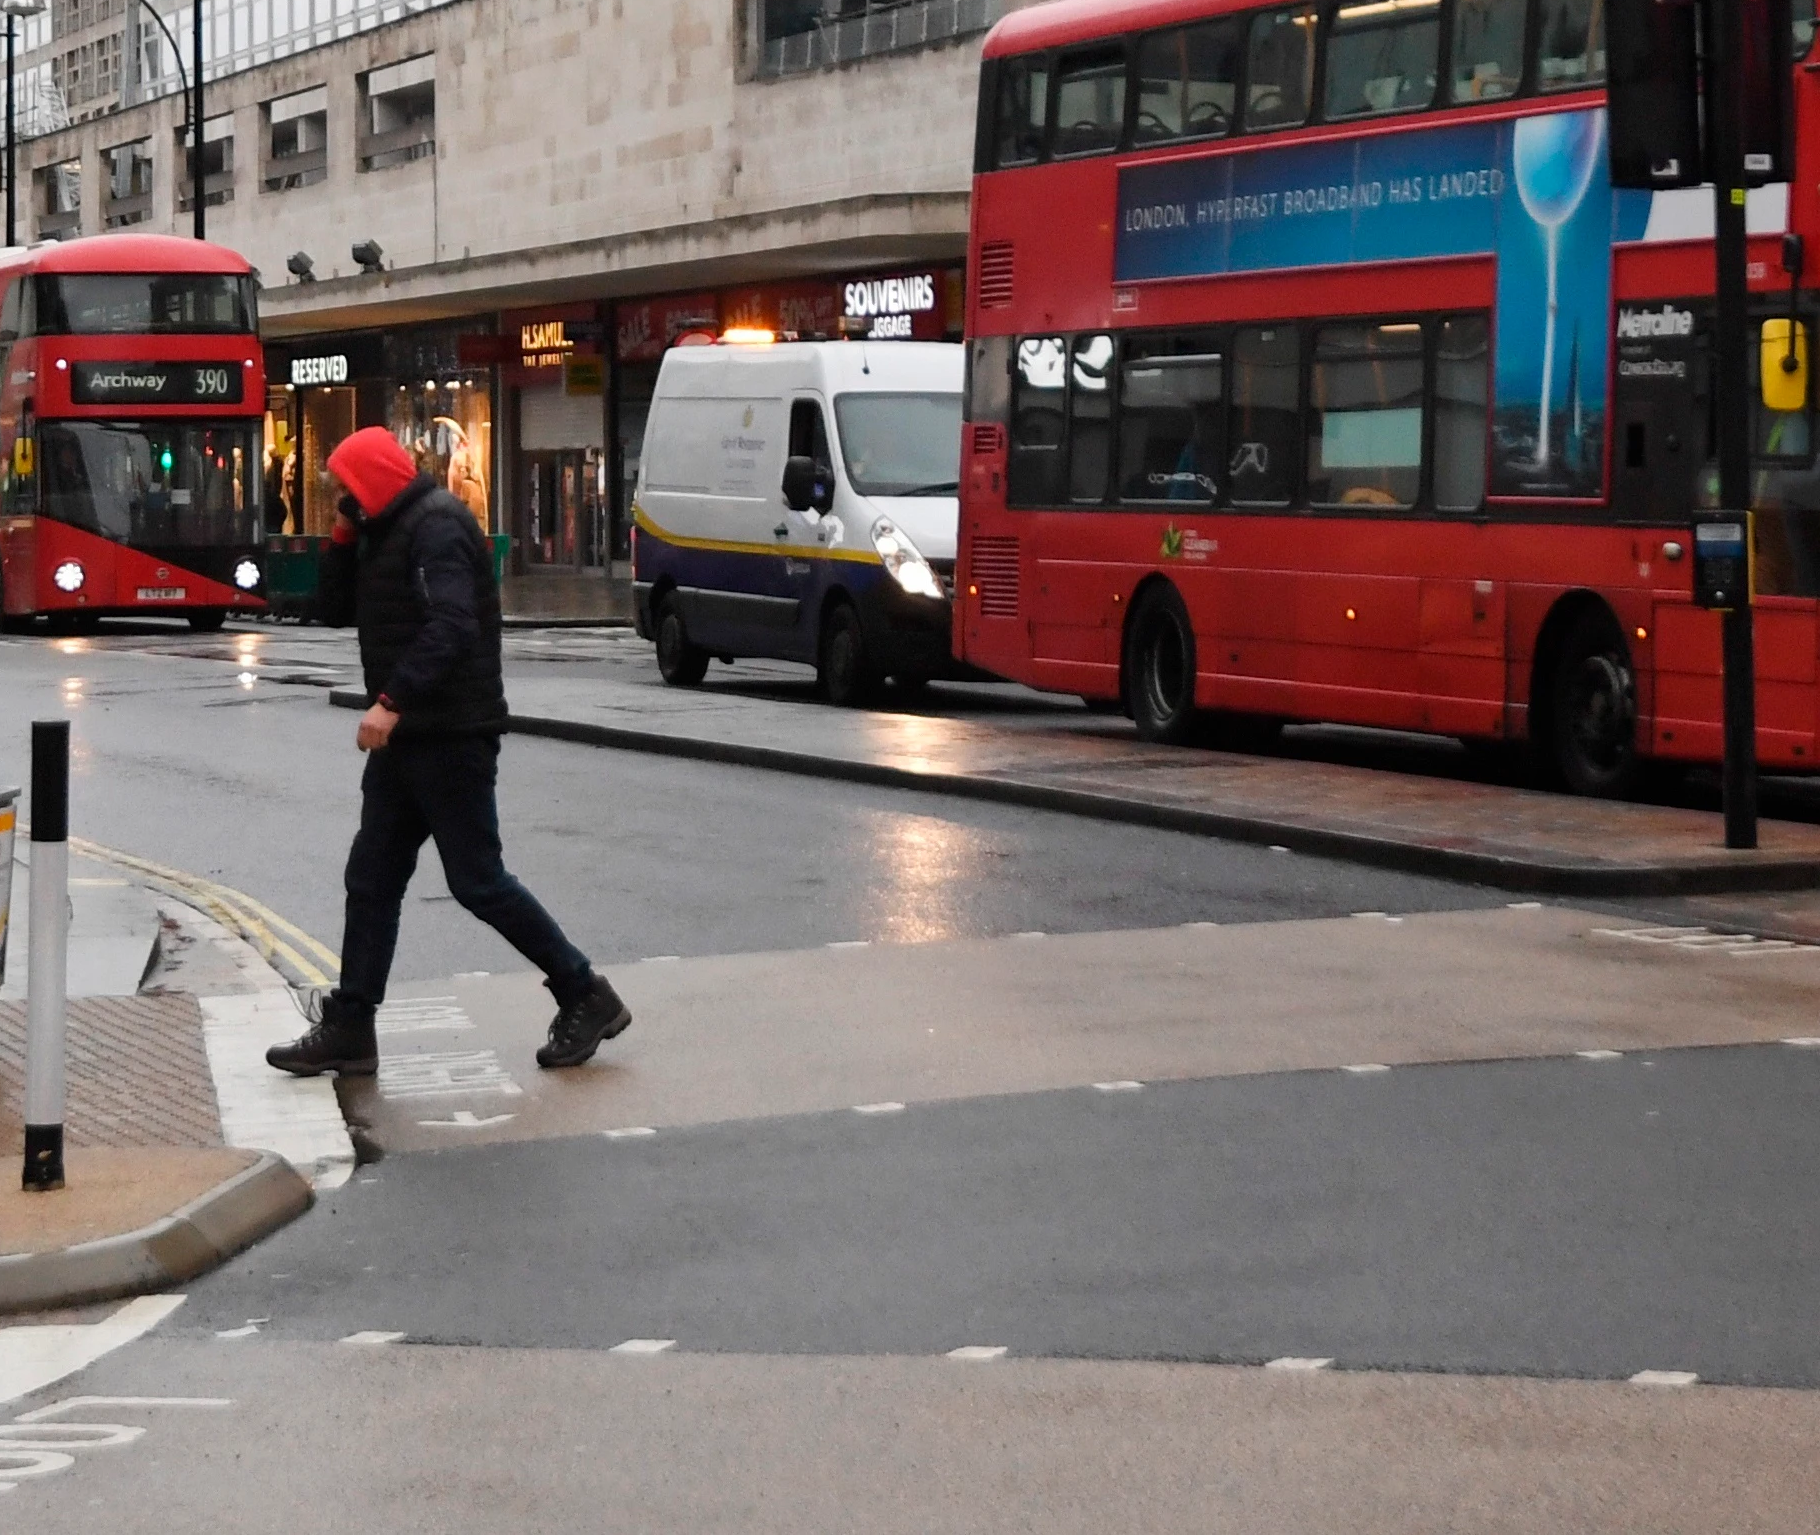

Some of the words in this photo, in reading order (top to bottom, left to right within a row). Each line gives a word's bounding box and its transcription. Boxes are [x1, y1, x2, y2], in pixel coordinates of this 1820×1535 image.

[1126, 204, 1190, 232] LONDON,
[1197, 192, 1278, 224] HYPERFAST
[1284, 181, 1381, 215] BROADBAND
[1389, 176, 1422, 203] HAS
[1429, 168, 1504, 200] LANDED
[844, 275, 935, 317] SOUVENIRS
[522, 322, 573, 349] H.SAMU
[868, 315, 912, 337] UGGAGE
[1617, 304, 1694, 338] Metroline
[90, 371, 167, 391] Archway
[195, 369, 228, 394] 390
[291, 355, 348, 384] RESERVED
